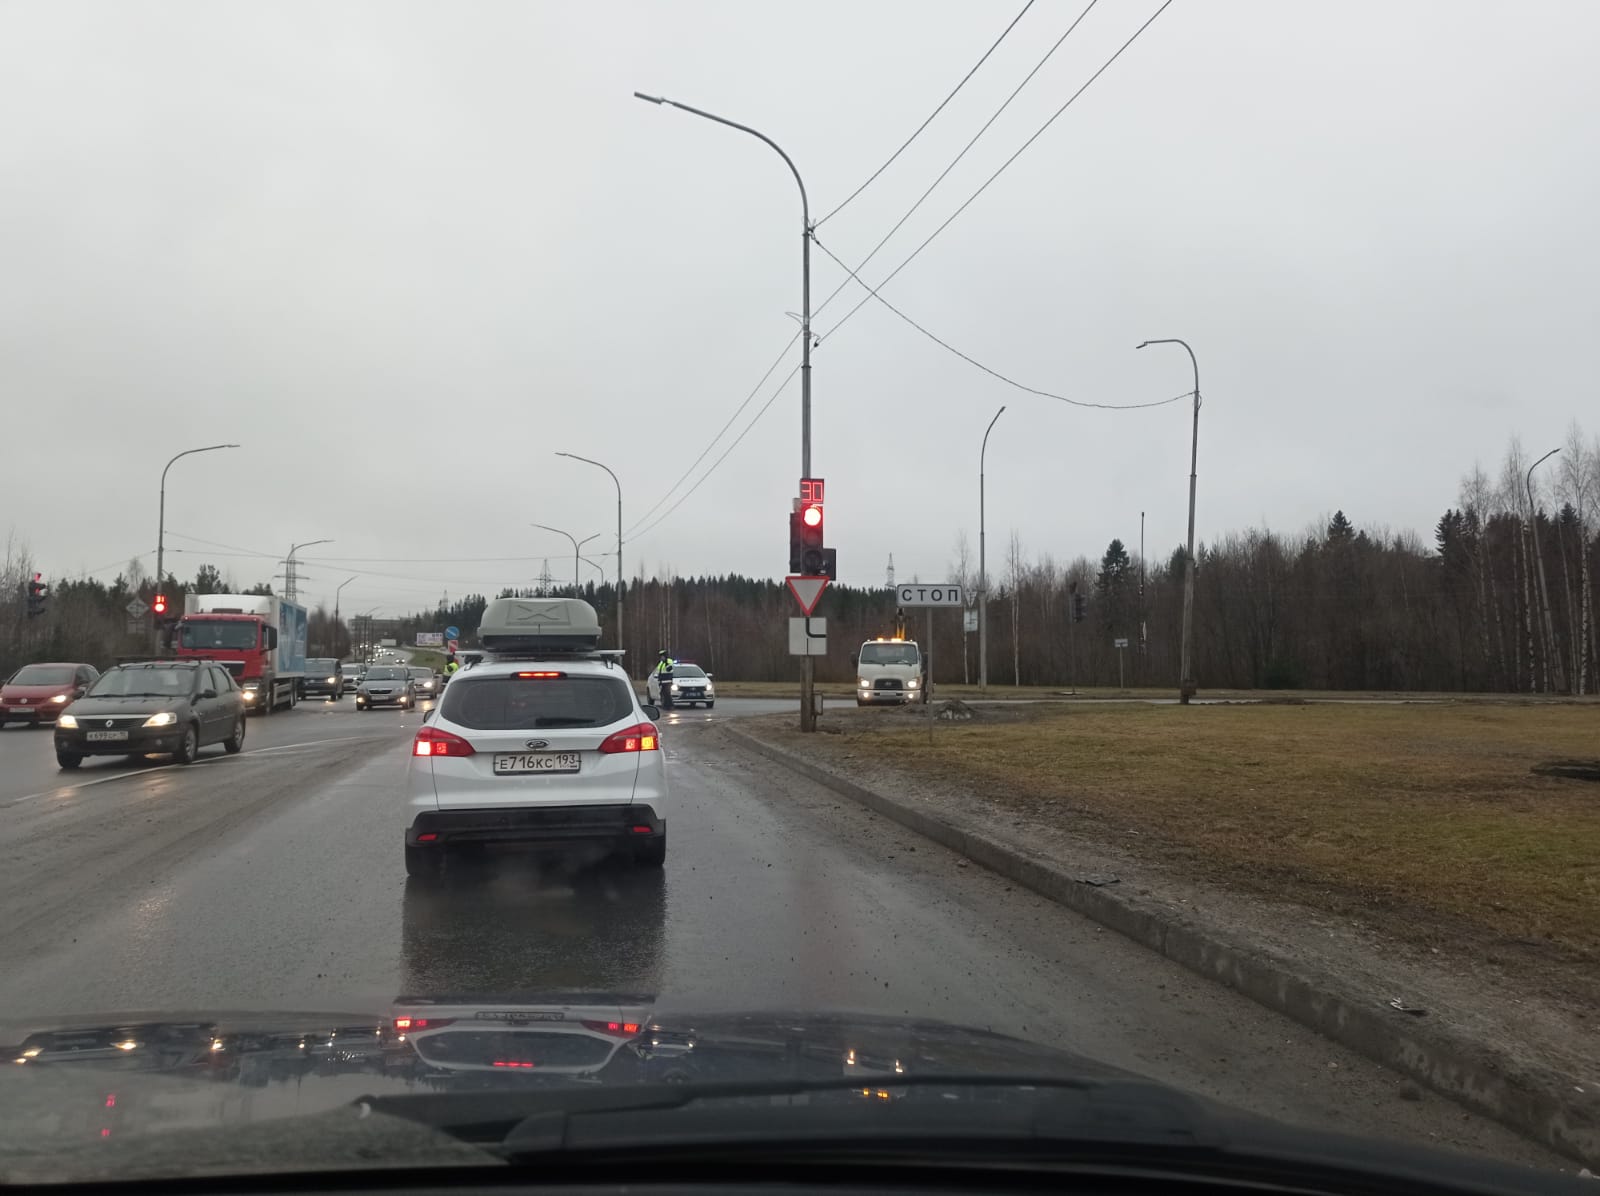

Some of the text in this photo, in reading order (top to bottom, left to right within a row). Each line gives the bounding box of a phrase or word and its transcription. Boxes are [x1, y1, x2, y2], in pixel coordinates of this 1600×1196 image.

[801, 481, 824, 502] 30
[902, 589, 958, 601] СТОП
[500, 754, 576, 769] Е716КС 193
